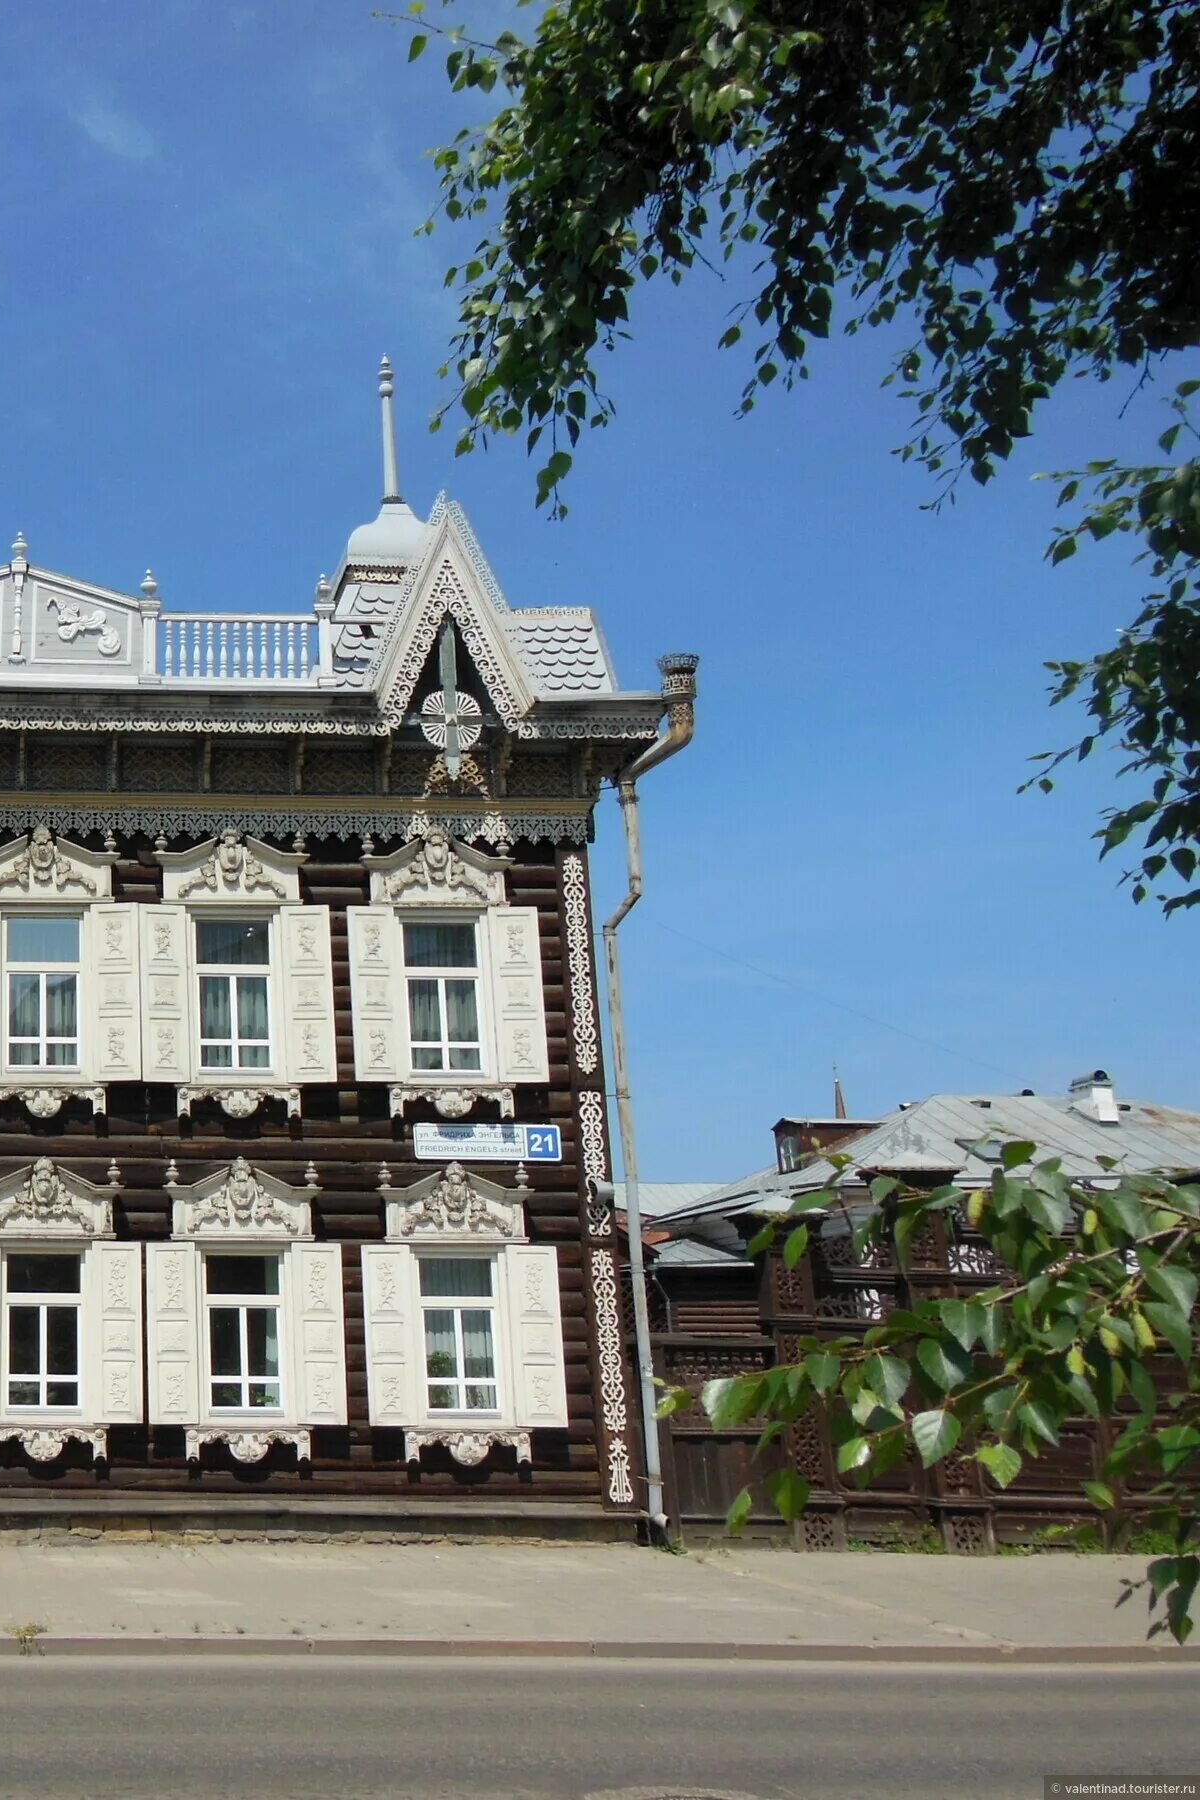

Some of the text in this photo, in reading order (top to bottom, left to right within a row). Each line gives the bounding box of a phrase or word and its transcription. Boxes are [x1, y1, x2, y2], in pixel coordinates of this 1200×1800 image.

[432, 1130, 477, 1139] ФРИДРИХА
[478, 1131, 520, 1139] ЭНГЕЛЬСА
[530, 1133, 554, 1152] 21
[419, 1145, 522, 1154] FRIEDRICH ENGELS street
